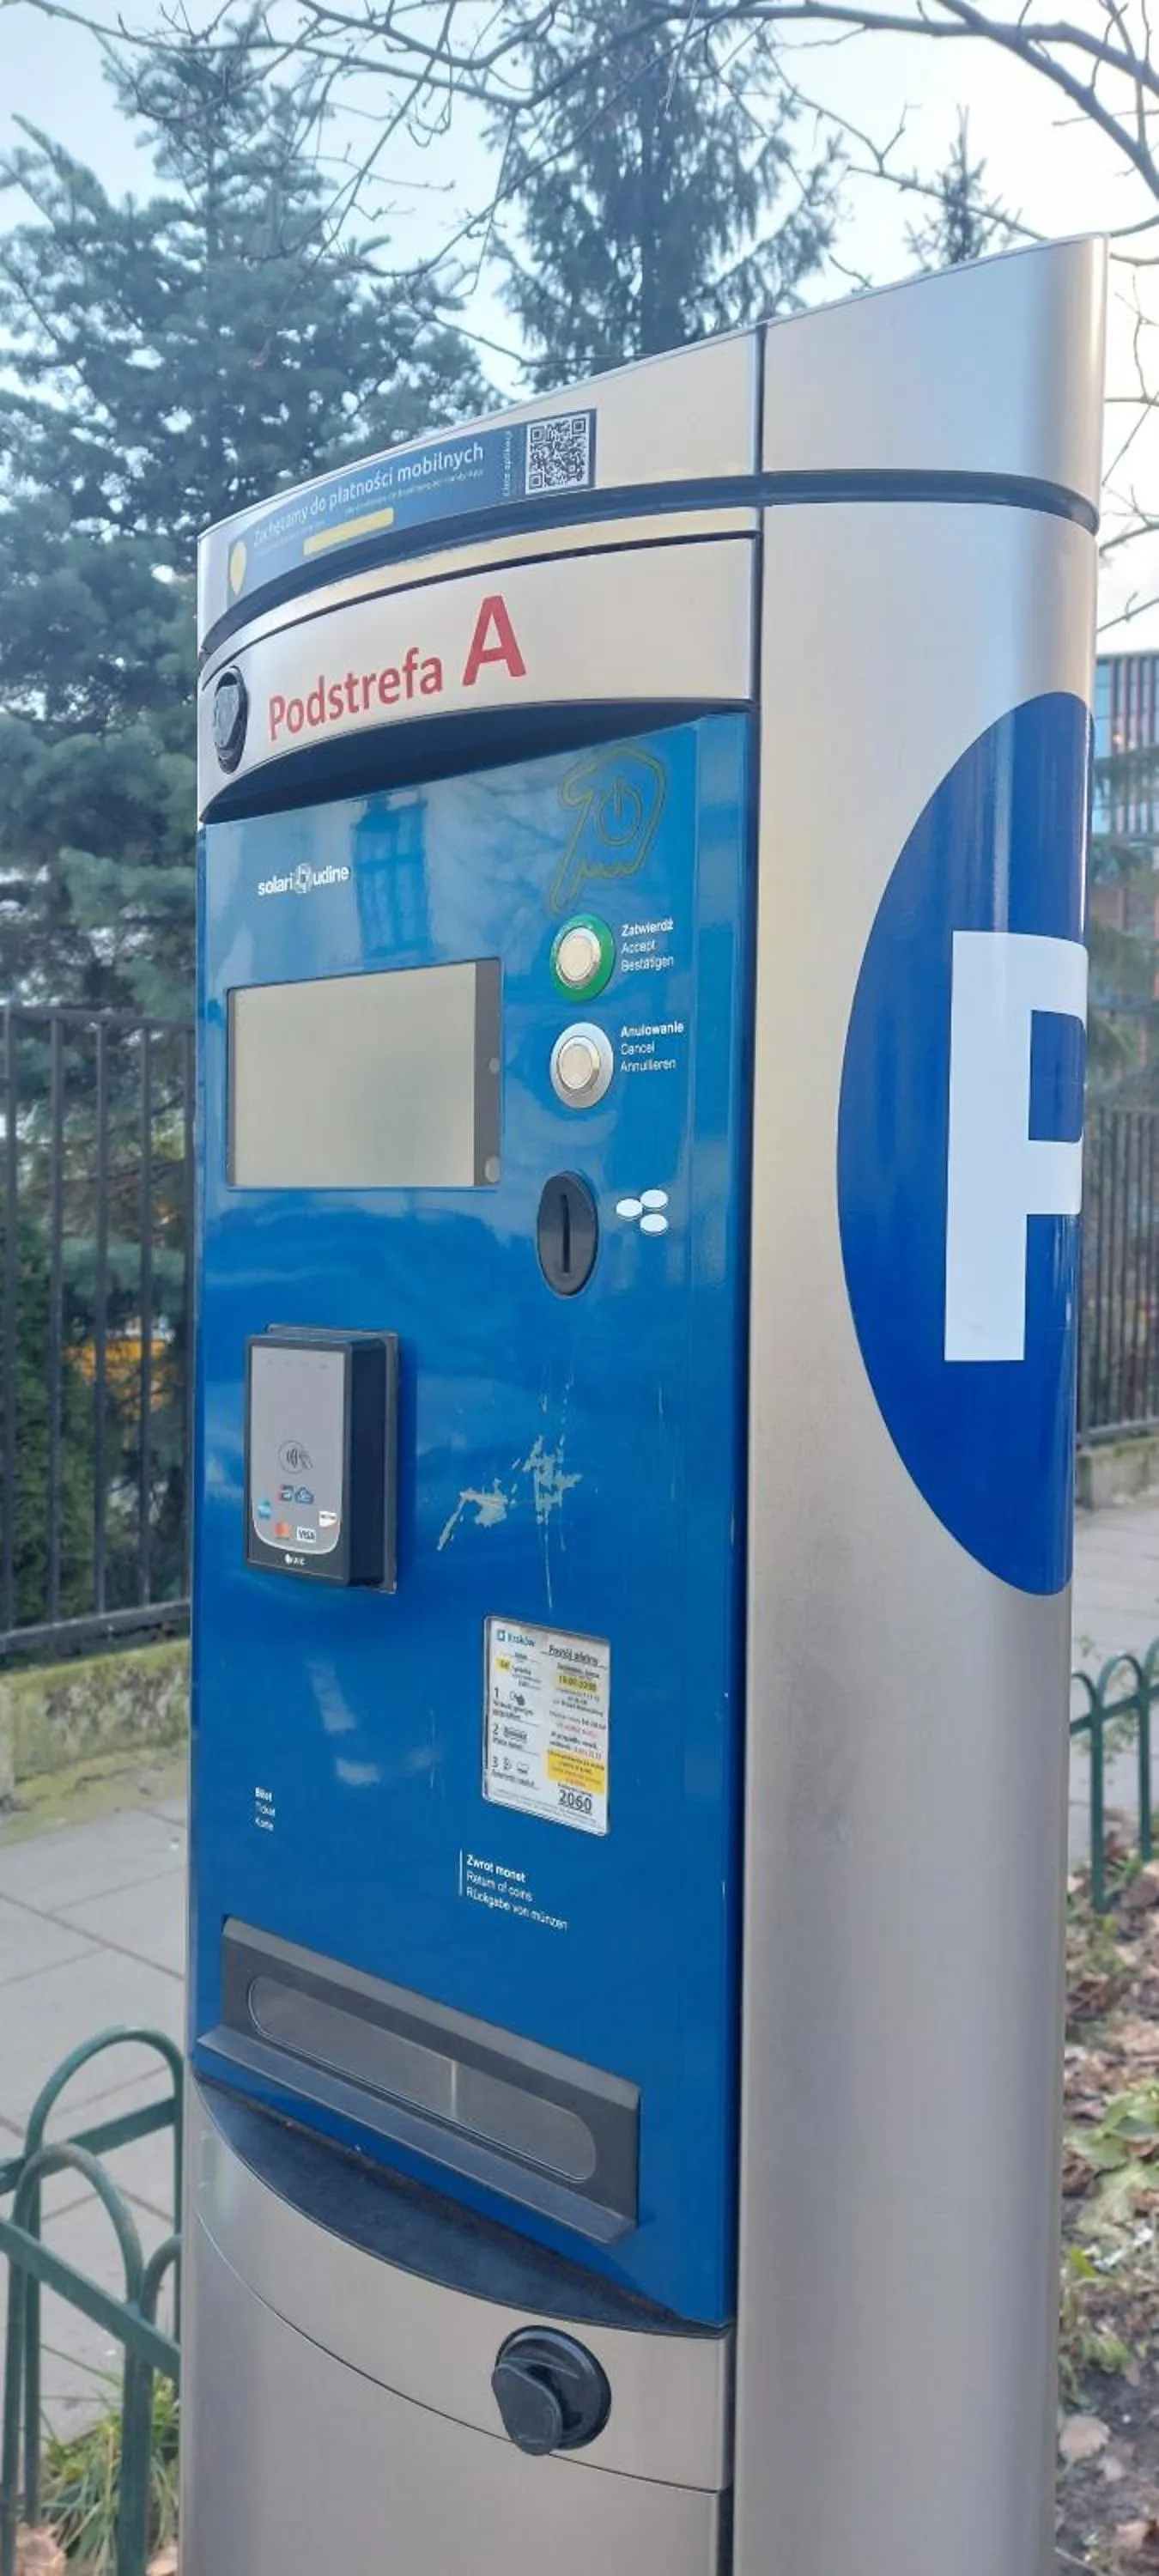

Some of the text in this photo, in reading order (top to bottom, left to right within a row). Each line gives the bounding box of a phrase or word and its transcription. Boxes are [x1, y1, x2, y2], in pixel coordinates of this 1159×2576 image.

[310, 492, 326, 515] do
[397, 441, 483, 482] mobilnych
[268, 593, 527, 742] Podstrefa A
[258, 866, 349, 896] solari udine
[622, 917, 674, 937] Zatwierdź
[622, 939, 656, 955] Accept
[621, 1020, 684, 1037] Anulowanie
[621, 1041, 655, 1055] Cancel
[944, 931, 1089, 1363] P
[558, 1789, 592, 1813] 2060
[466, 1854, 494, 1873] Zwrot
[466, 1870, 496, 1889] Return
